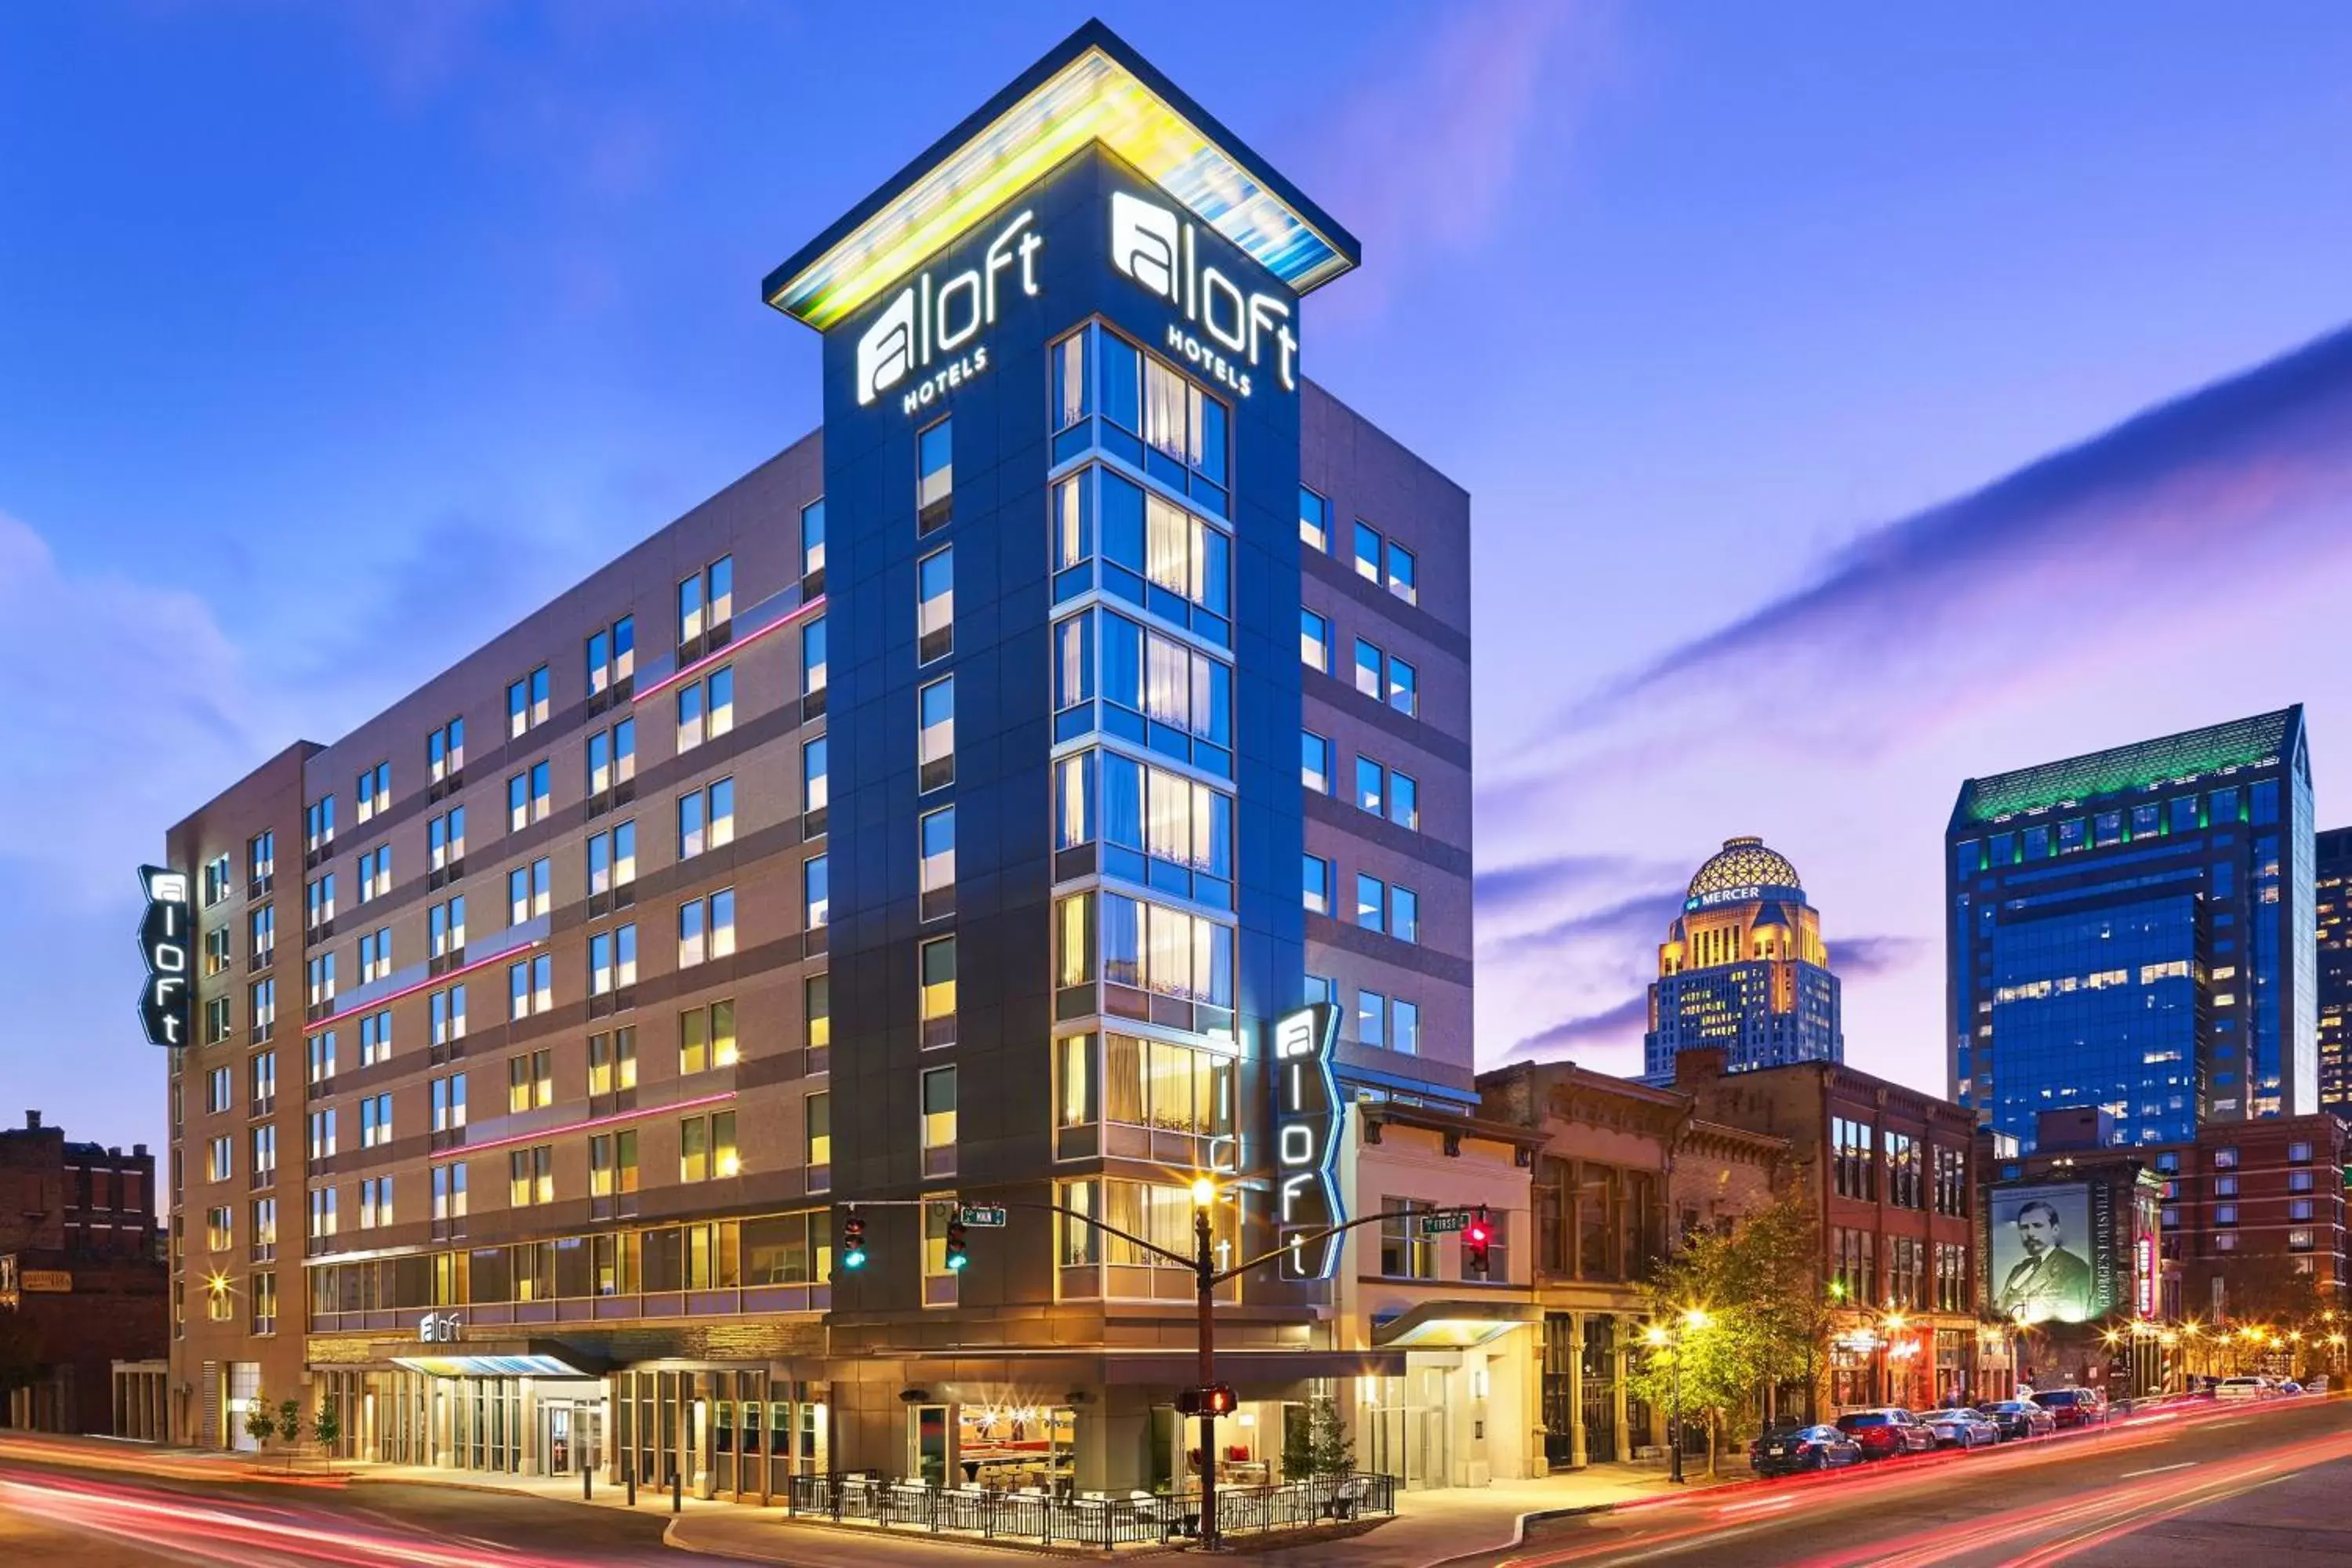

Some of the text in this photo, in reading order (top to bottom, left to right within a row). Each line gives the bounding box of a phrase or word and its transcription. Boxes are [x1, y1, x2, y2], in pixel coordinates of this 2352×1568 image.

[858, 209, 1041, 405] aloft
[1112, 190, 1297, 392] aloft
[903, 347, 988, 416] HOTELS
[1168, 325, 1252, 397] HOTELS
[1702, 887, 1759, 905] MERCER
[2097, 1253, 2110, 1307] GEORGE'S
